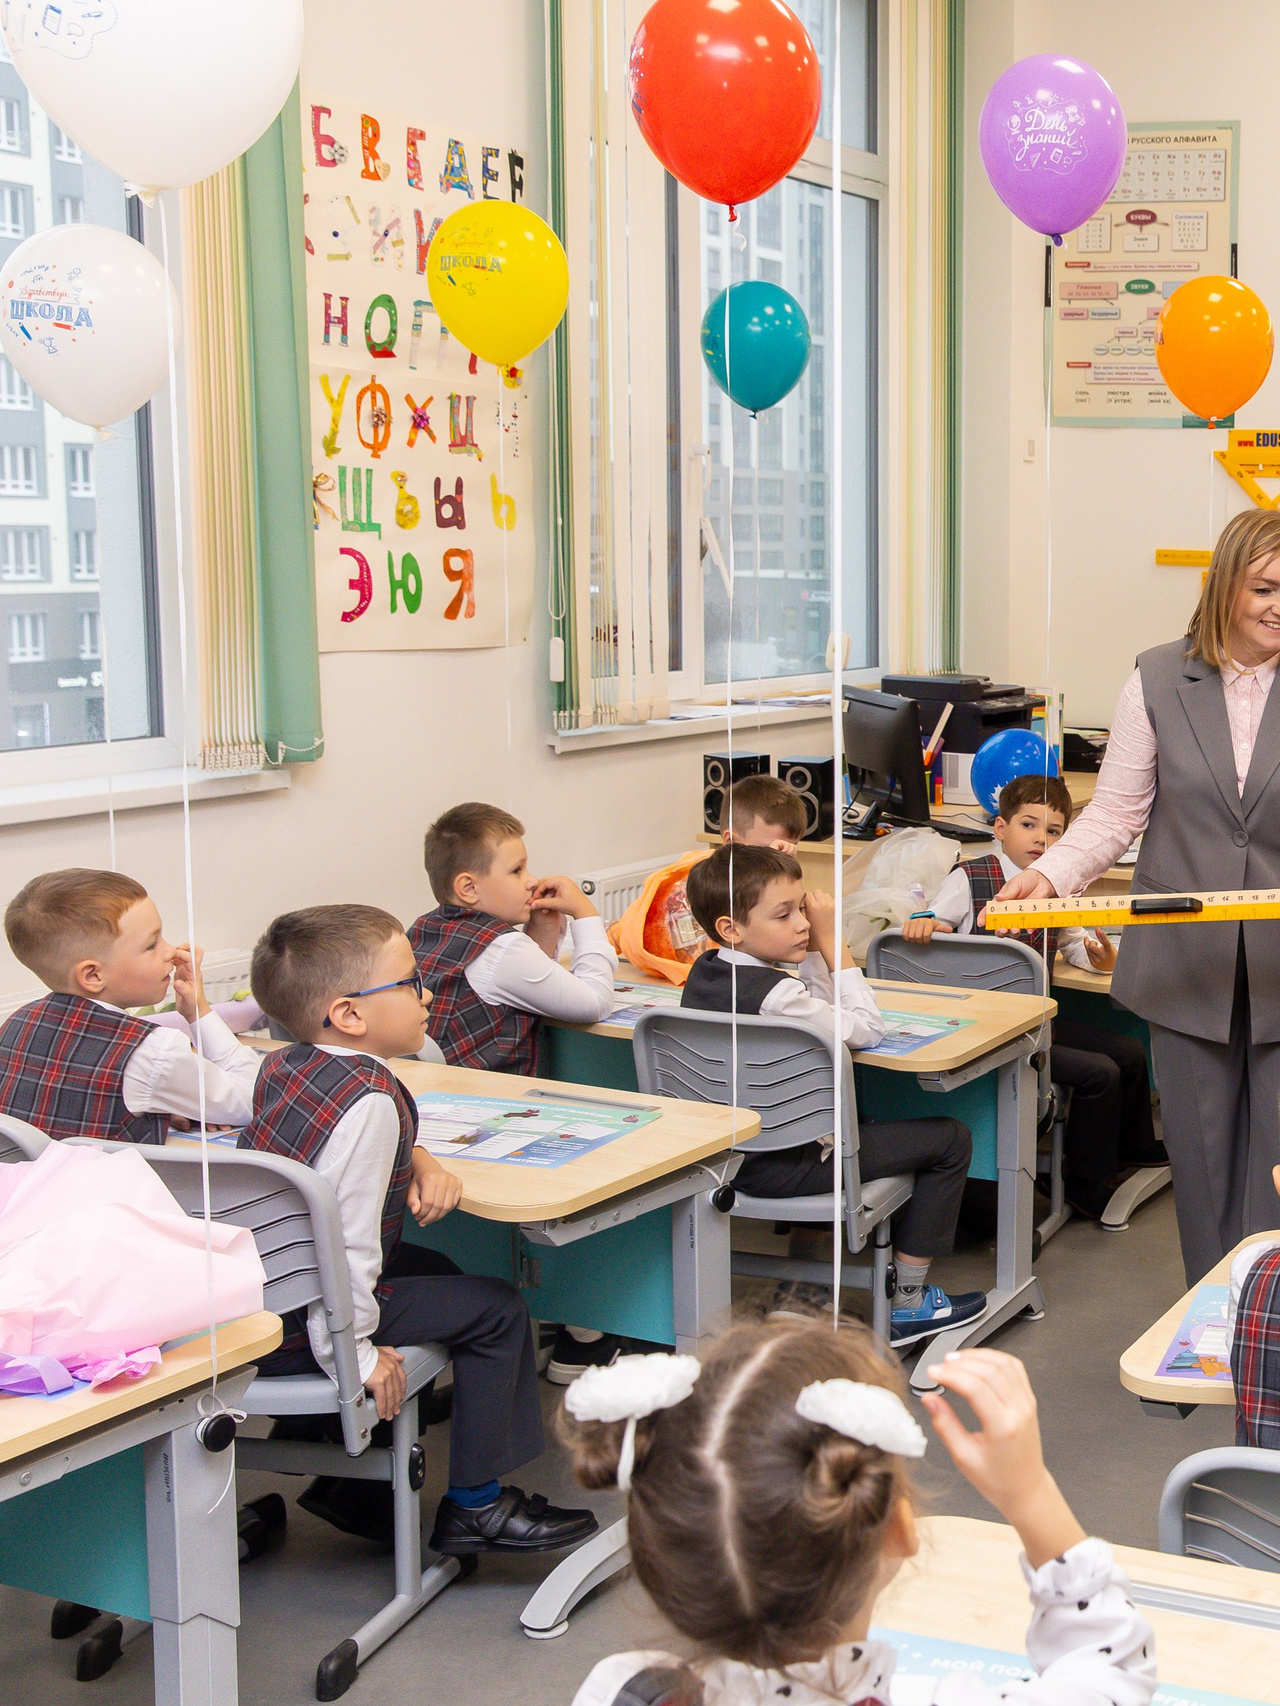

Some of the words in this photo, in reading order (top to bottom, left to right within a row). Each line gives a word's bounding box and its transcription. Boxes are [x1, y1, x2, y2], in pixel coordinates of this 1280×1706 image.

[1025, 107, 1070, 134] День
[1015, 130, 1078, 162] знаний
[1131, 136, 1172, 145] РУССКОГО
[1173, 135, 1218, 144] АЛФАВИТА
[361, 113, 390, 182] В
[407, 126, 426, 191] Г
[439, 138, 475, 200] Д
[440, 255, 503, 273] ШКОЛА
[11, 299, 93, 327] ШКОЛА
[322, 293, 350, 347] Н
[365, 294, 398, 359] О
[319, 374, 351, 459] У
[356, 375, 392, 459] Ф
[404, 393, 437, 448] Х
[448, 392, 484, 462] Ц
[338, 465, 381, 540] Щ
[339, 547, 373, 623] Э
[388, 550, 423, 614] Ю
[443, 548, 476, 620] Я
[930, 1657, 985, 1673] МОЙ
